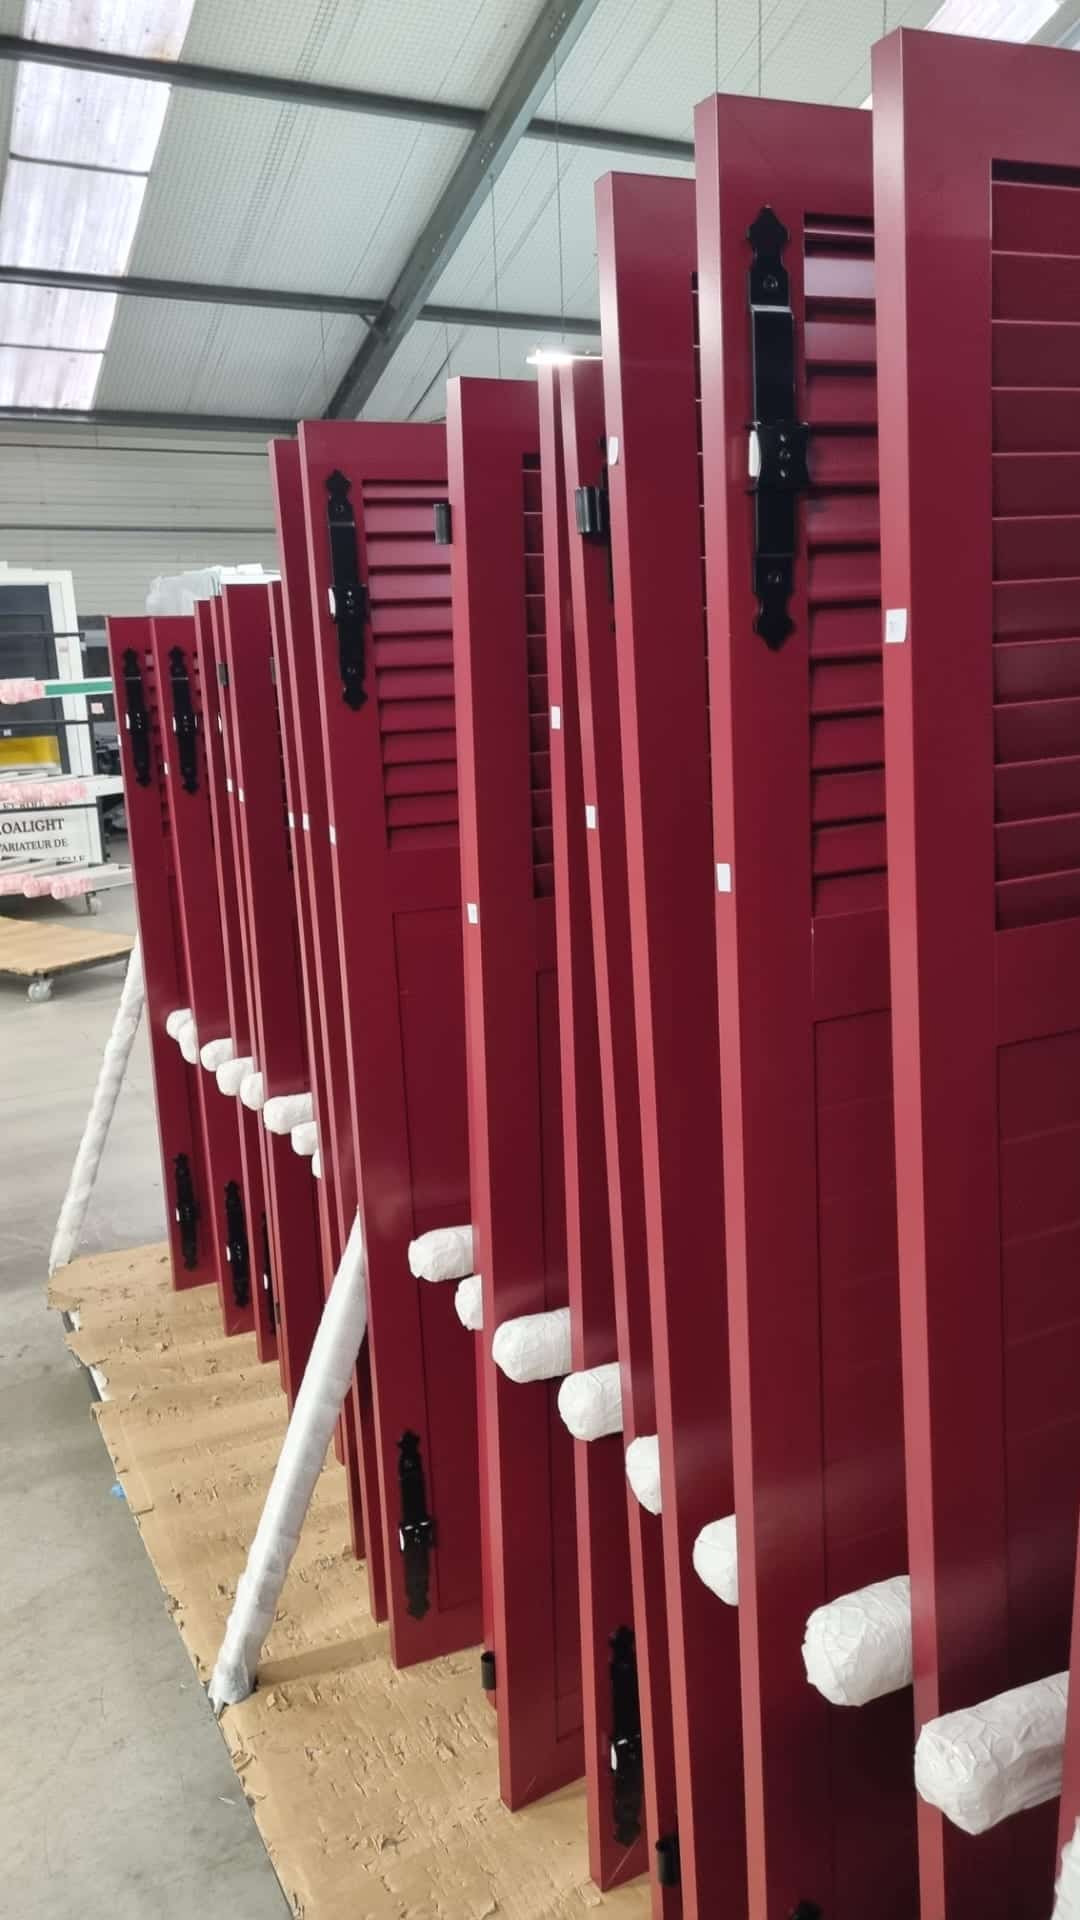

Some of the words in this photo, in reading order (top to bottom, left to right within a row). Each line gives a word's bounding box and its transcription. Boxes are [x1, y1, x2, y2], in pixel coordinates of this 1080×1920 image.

[0, 818, 64, 835] OALIGHT
[0, 839, 52, 853] ARIATEUR
[54, 838, 68, 848] DE
